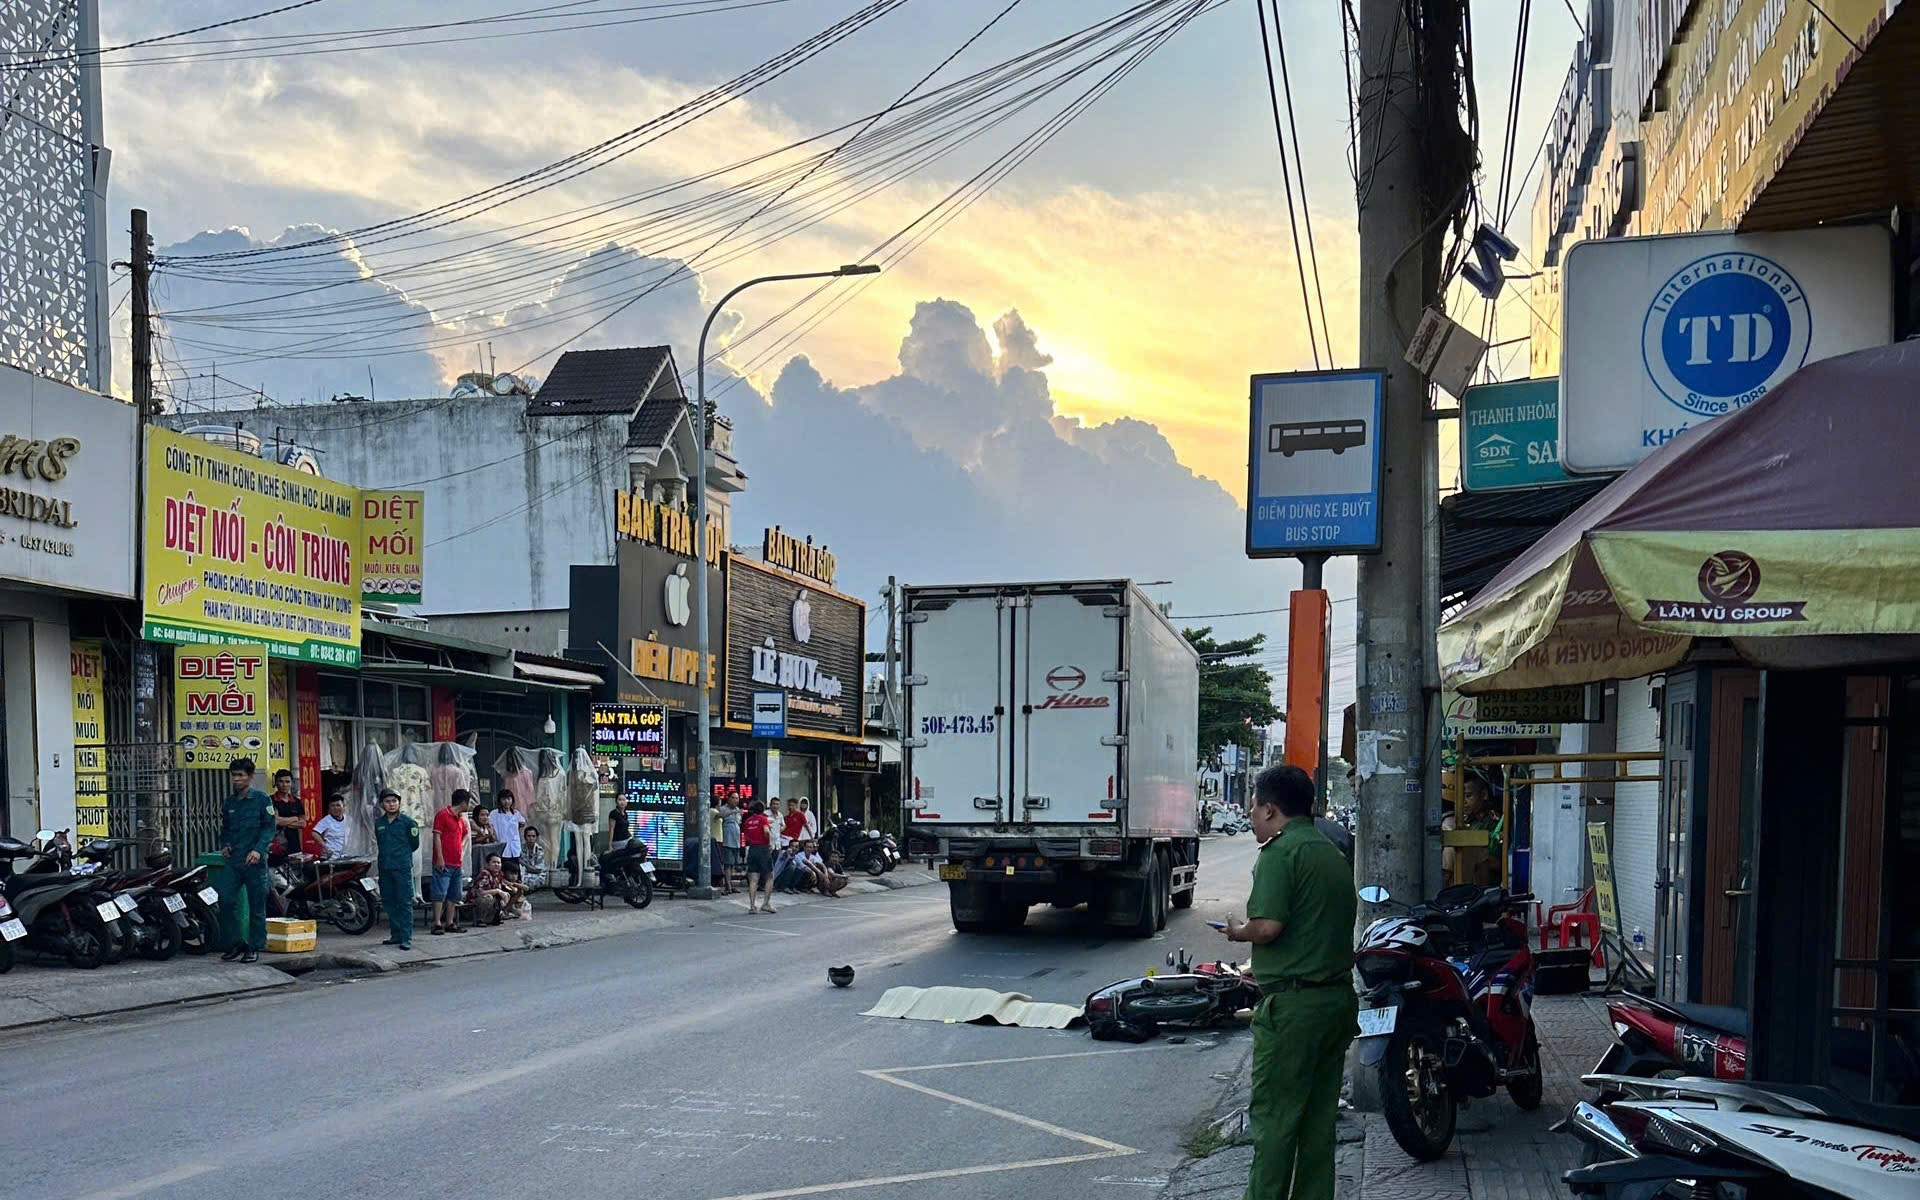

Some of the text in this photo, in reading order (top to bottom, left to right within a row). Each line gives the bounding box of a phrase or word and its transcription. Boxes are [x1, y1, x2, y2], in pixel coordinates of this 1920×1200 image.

[1654, 256, 1802, 314] International
[1679, 312, 1774, 366] TD
[1470, 400, 1557, 426] THANH NHÔM
[1684, 391, 1729, 413] Since
[1480, 445, 1512, 458] SDN
[166, 444, 191, 474] CÔNG
[193, 455, 205, 477] TY
[207, 459, 230, 485] TNHH
[232, 464, 256, 491] CÔNG
[282, 480, 300, 505] SINH
[302, 486, 318, 511] HỌC
[321, 491, 334, 513] LAN
[336, 496, 351, 518] ANH
[364, 495, 419, 525] DIỆT
[616, 486, 656, 543] BÁN
[659, 501, 691, 556] TRẢ
[1258, 498, 1372, 521] ĐIỂM DỪNG XE BUÝT
[165, 490, 207, 566] DIỆT
[212, 497, 247, 565] MỐI
[263, 513, 297, 577] CÔN
[301, 525, 351, 586] TRÙNG
[369, 528, 415, 556] MỐI
[1286, 525, 1341, 542] BUS STOP
[765, 525, 836, 584] BÁN TRẢ GÓP
[269, 583, 284, 601] CHO
[1659, 603, 1793, 620] LÂM VŨ GROUP
[179, 650, 263, 684] DIỆT
[669, 646, 717, 689] APPE
[752, 636, 778, 686] LÊ
[778, 652, 819, 692] HUY
[77, 688, 95, 710] MỐI
[186, 682, 256, 716] MỐI
[594, 709, 661, 726] BÁN TRẢ GÓP
[921, 715, 995, 735] 50E-473.45
[1468, 724, 1552, 736] 0908.90.77.81
[595, 727, 615, 741] SỬA
[617, 727, 635, 741] LẤY
[197, 752, 222, 763] 0342
